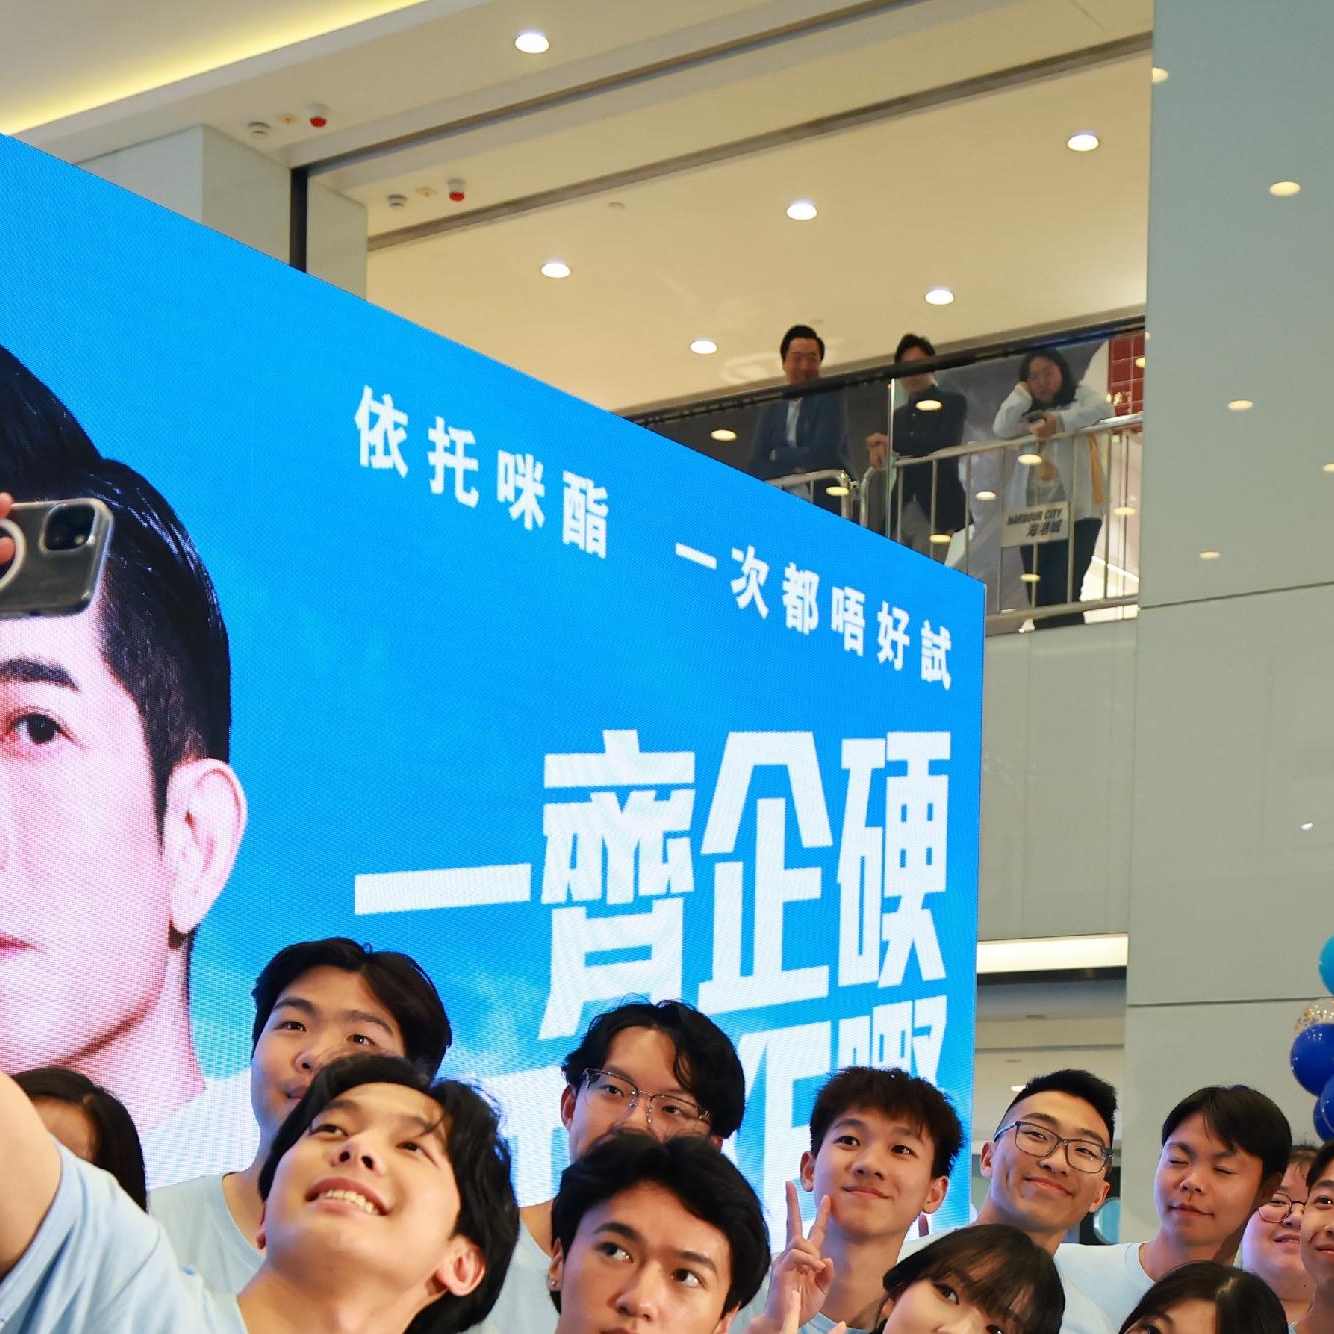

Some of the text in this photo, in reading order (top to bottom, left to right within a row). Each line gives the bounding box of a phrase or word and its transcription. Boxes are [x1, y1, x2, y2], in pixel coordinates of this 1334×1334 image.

[353, 386, 953, 690] 依托咪酯 一次都唔好試
[354, 729, 953, 1040] 一齊企硬
